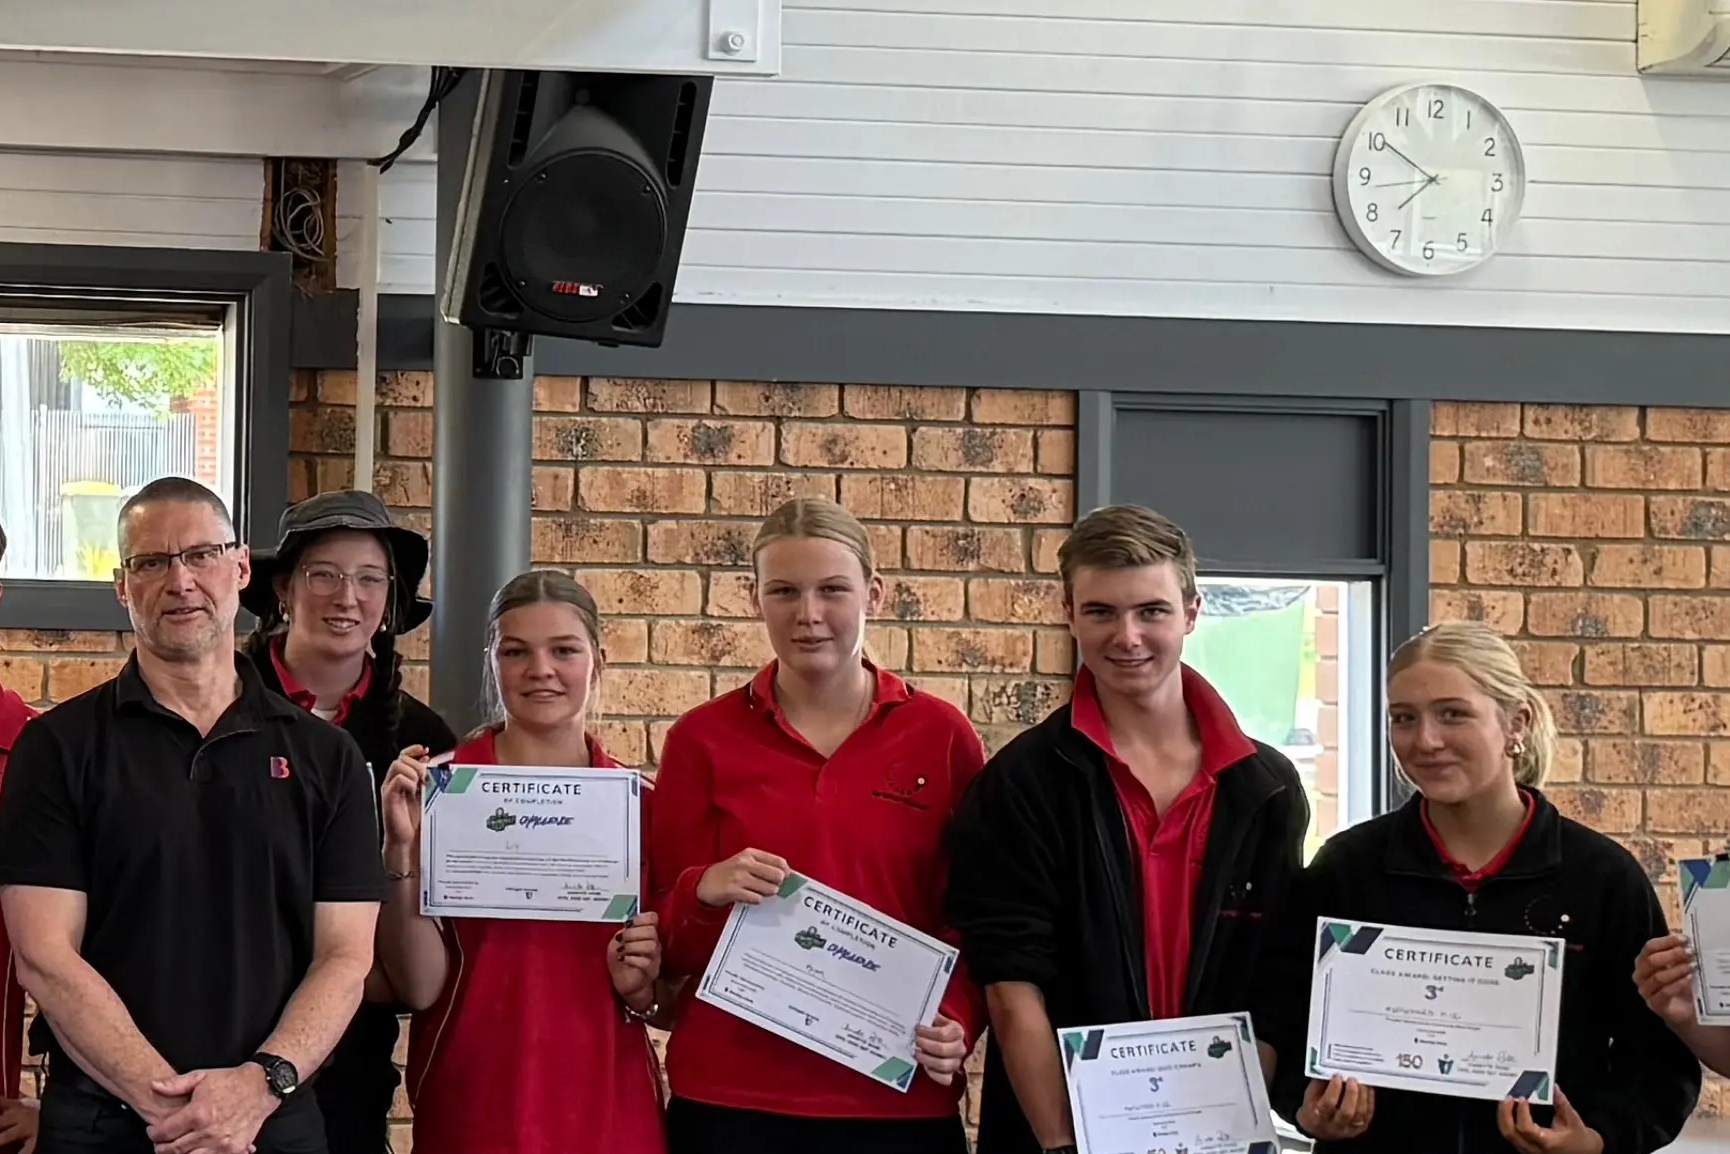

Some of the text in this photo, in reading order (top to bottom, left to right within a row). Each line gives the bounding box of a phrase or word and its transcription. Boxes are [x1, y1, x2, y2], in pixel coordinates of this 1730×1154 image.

[1396, 108, 1408, 127] 11
[1428, 100, 1444, 118] 12
[1467, 111, 1471, 129] 1
[1369, 133, 1386, 151] 10
[1484, 138, 1495, 157] 2
[1359, 167, 1371, 185] 9
[1492, 173, 1503, 192] 3
[1366, 203, 1378, 222] 8
[1481, 208, 1492, 226] 4
[1390, 230, 1402, 249] 7
[1457, 233, 1468, 251] 5
[1423, 242, 1434, 260] 6
[270, 756, 290, 778] B
[482, 782, 580, 795] CERTIFICATE
[803, 895, 898, 948] CERTIFICATE
[1385, 948, 1493, 968] CERTIFICATE
[1111, 1040, 1196, 1058] CERTIFICATE
